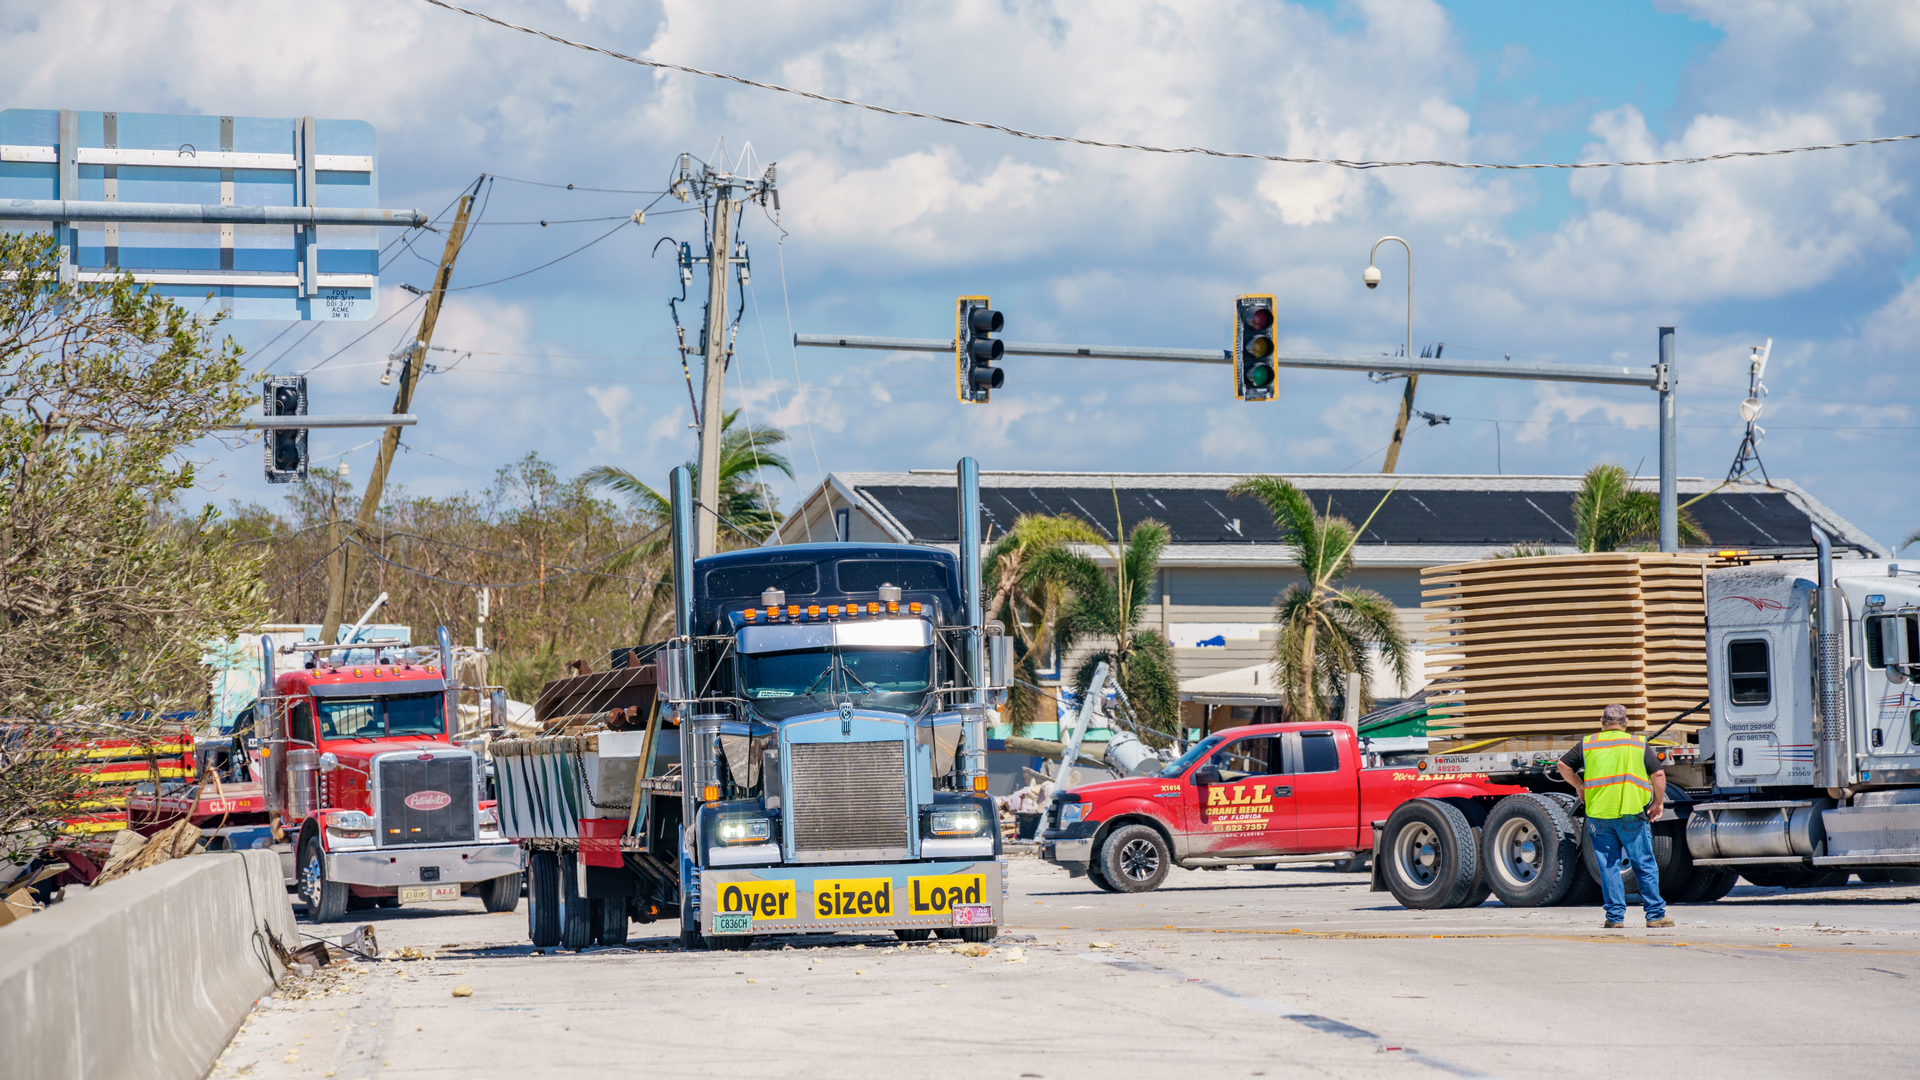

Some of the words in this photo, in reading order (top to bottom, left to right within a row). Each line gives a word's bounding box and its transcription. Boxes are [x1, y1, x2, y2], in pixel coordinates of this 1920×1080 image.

[411, 794, 448, 806] Peterbilt
[1207, 785, 1272, 806] ALL
[1205, 807, 1238, 815] CRANE
[1238, 805, 1274, 814] RENTAL
[723, 885, 789, 917] Over
[818, 882, 890, 916] sized
[913, 877, 980, 912] Load
[720, 919, 747, 928] C836CH
